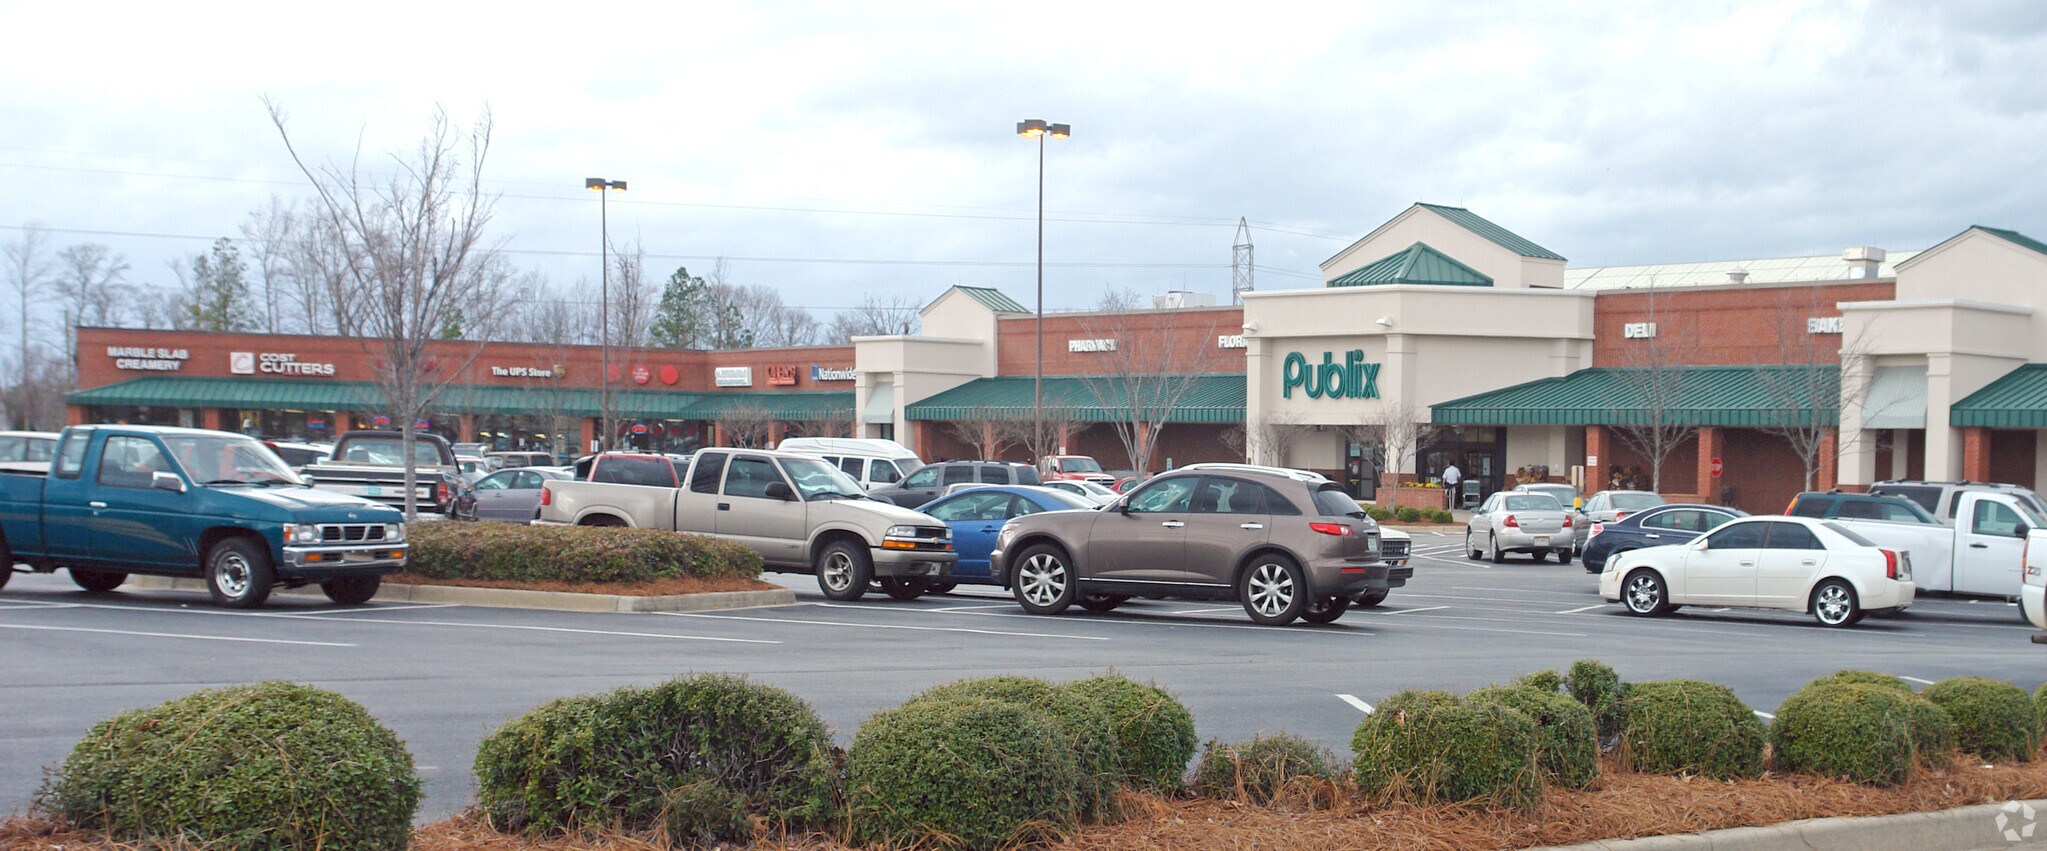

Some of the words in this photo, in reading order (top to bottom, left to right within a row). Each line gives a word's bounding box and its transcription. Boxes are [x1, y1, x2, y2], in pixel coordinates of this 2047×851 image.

[1625, 323, 1656, 338] DELI
[107, 346, 155, 358] MARBLE
[157, 348, 189, 360] SLAB
[260, 353, 295, 362] COST
[116, 358, 180, 371] CREAMERY
[260, 362, 335, 375] CUTTERS
[492, 366, 508, 376] The
[509, 367, 527, 377] UPS
[528, 368, 551, 378] Store
[818, 367, 857, 381] Nationwide
[1283, 349, 1381, 400] Publix
